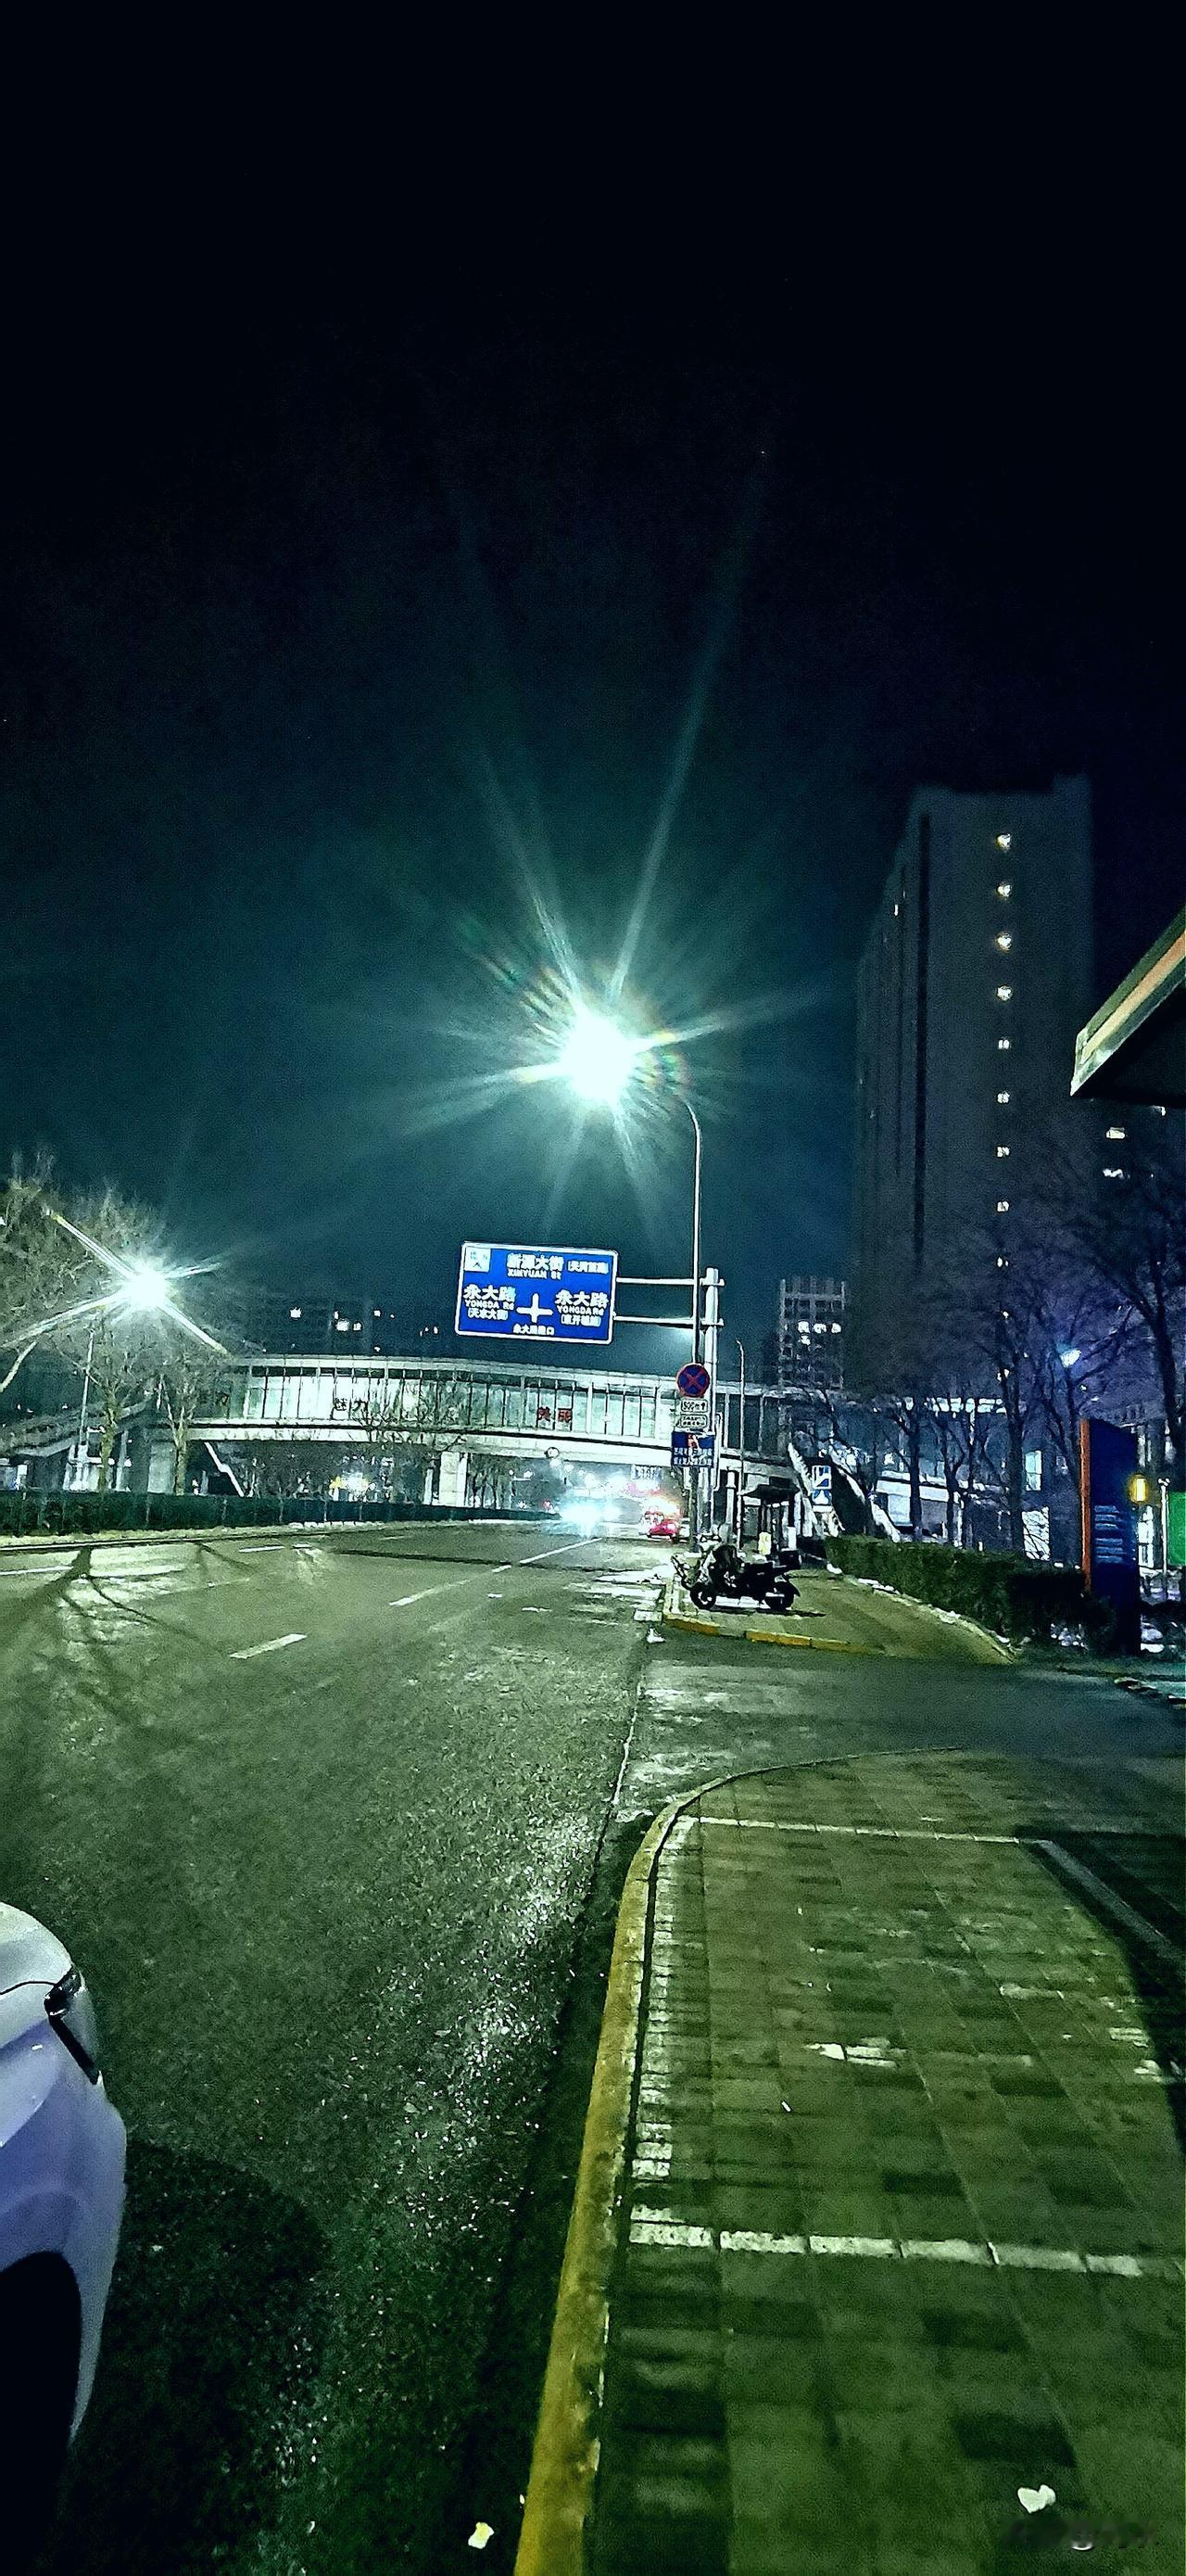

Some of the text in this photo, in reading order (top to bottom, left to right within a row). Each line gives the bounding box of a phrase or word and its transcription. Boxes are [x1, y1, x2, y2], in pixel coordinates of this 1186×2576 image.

[463, 1284, 516, 1302] 永大路
[554, 1289, 609, 1309] 永大路
[465, 1300, 499, 1309] YONGDA
[557, 1305, 591, 1315] YONGDA
